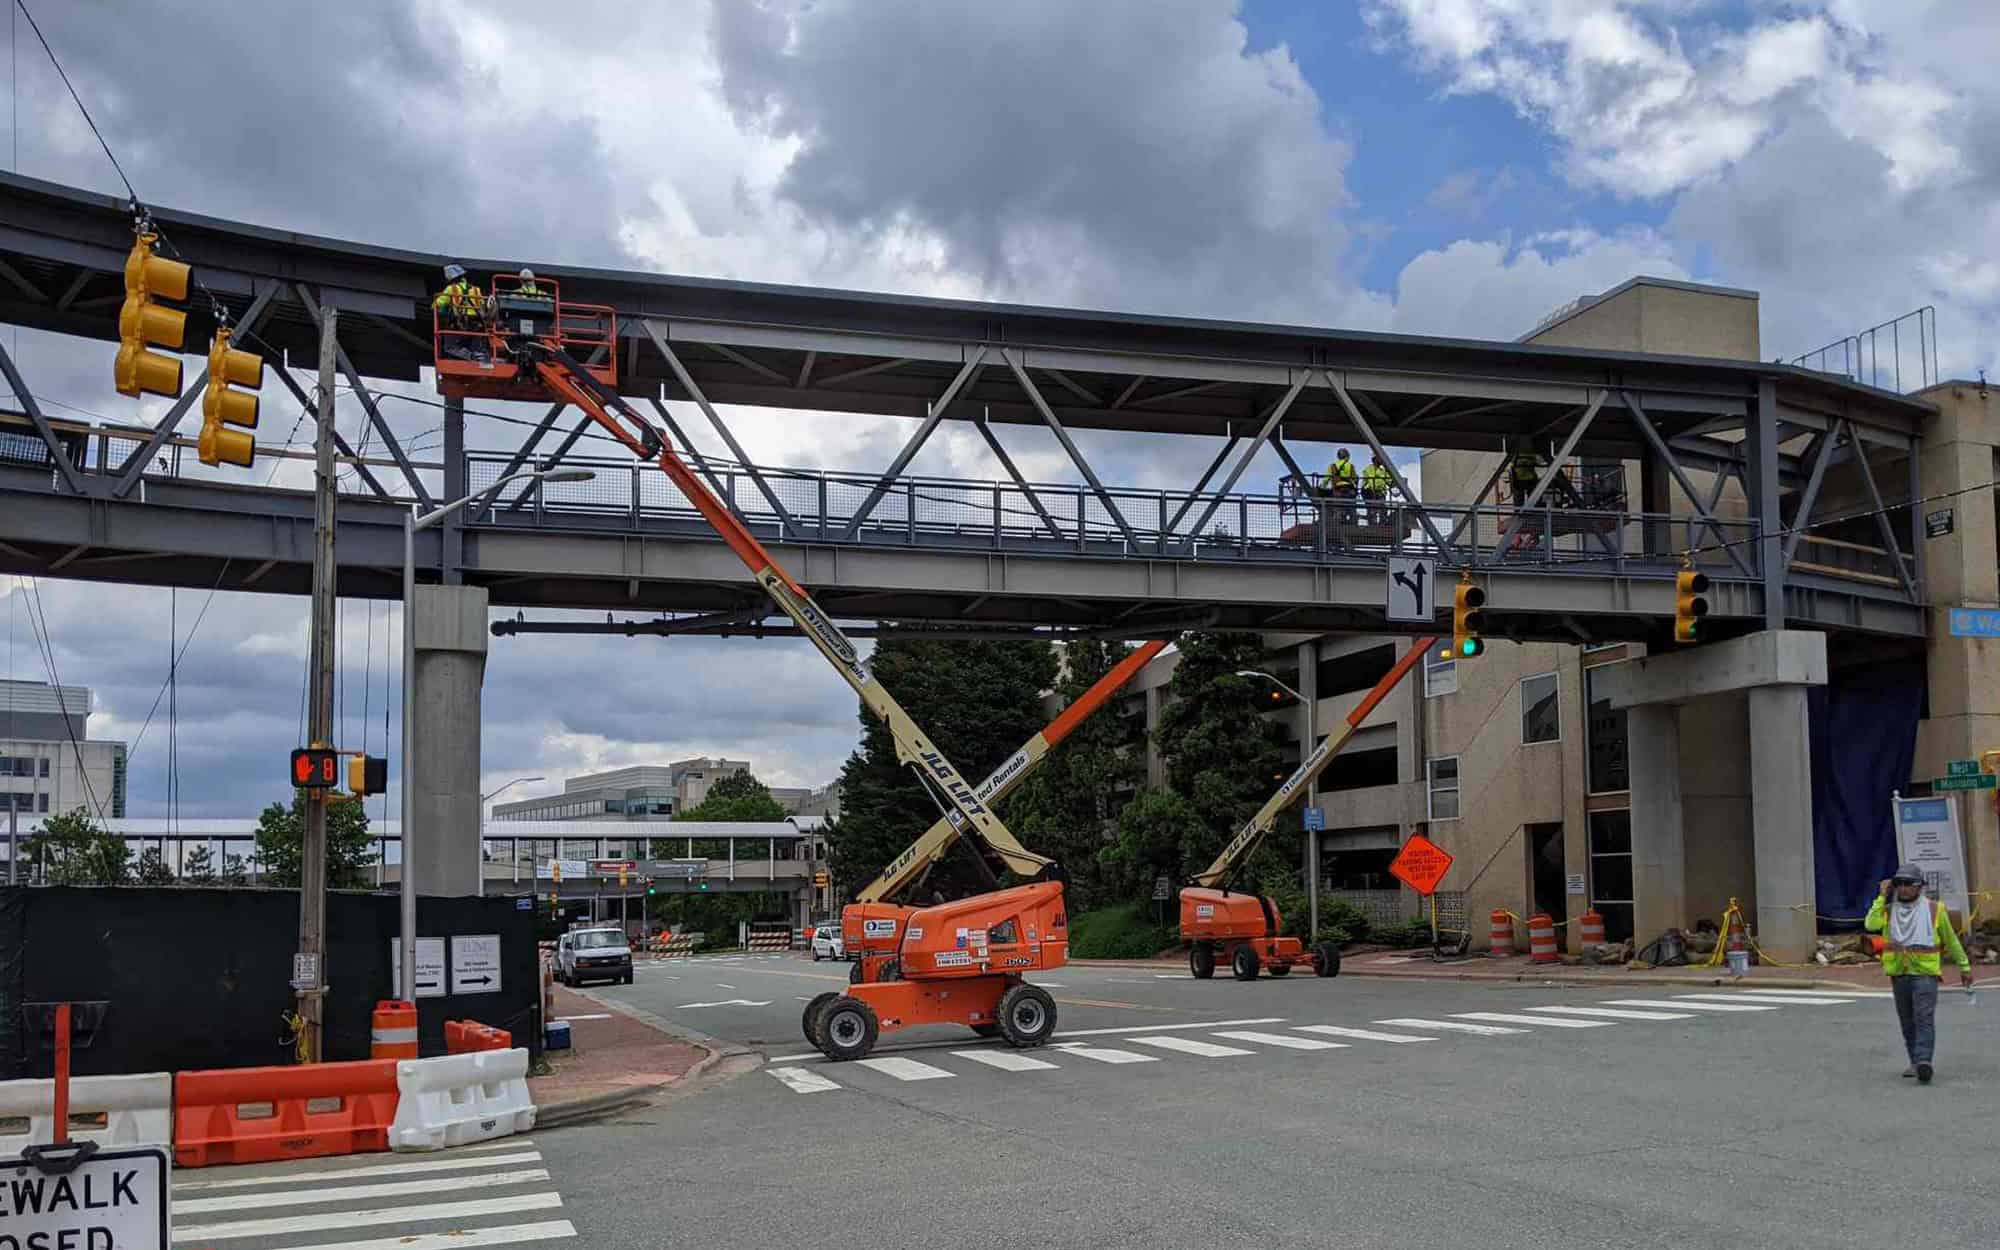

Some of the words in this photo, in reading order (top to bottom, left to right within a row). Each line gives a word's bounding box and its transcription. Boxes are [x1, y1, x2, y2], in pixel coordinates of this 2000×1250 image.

[920, 752, 954, 779] JLG
[948, 781, 986, 815] LIFT
[992, 755, 1026, 787] Rentals
[881, 863, 898, 882] JLG
[899, 845, 917, 867] LIFT
